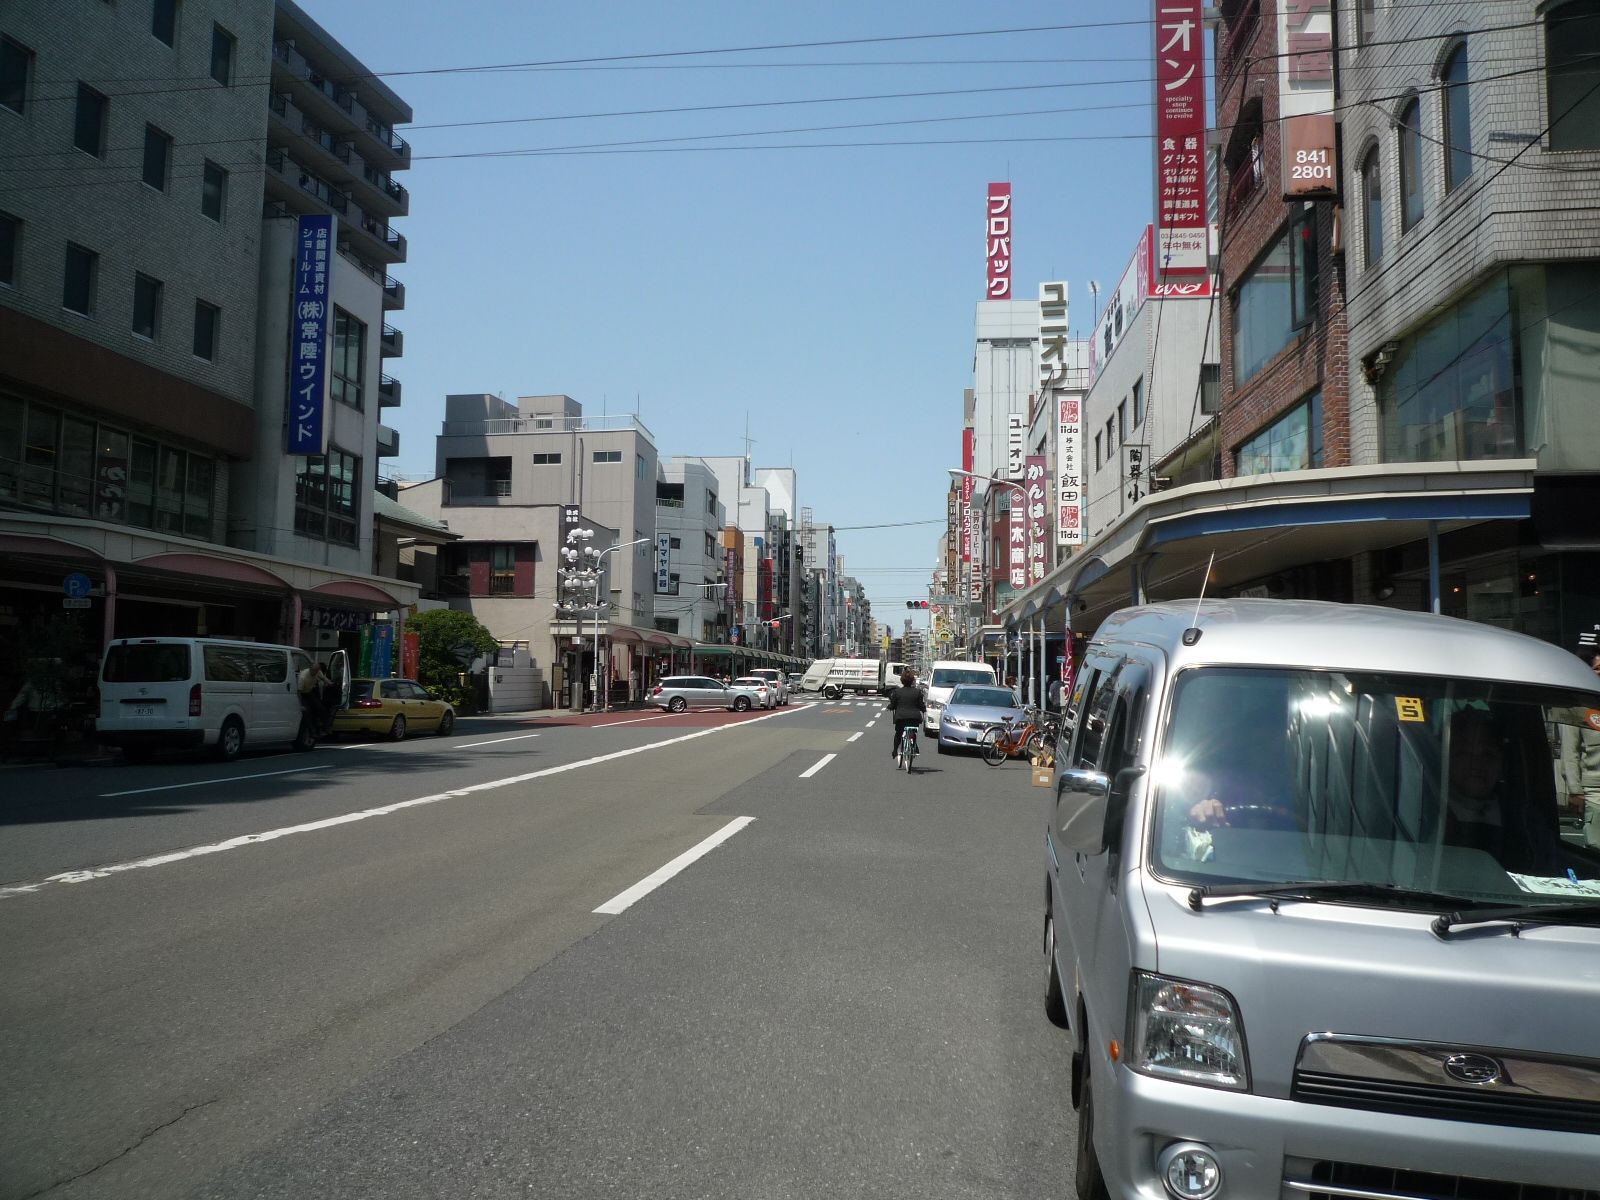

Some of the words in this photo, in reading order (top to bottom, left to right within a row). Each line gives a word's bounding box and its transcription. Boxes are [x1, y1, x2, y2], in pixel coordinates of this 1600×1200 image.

[1163, 154, 1198, 164] グラス
[1296, 150, 1326, 163] 841
[1291, 165, 1332, 179] 2801
[989, 194, 1011, 297] プロパック
[1162, 241, 1202, 251] 年中無休
[300, 228, 313, 294] ショールーム
[1040, 284, 1068, 388] ユニオン
[1060, 425, 1079, 433] iida
[1009, 418, 1022, 474] ユニオン
[1011, 507, 1025, 585] 三木商店
[69, 580, 80, 594] P
[971, 564, 982, 601] ユニオン
